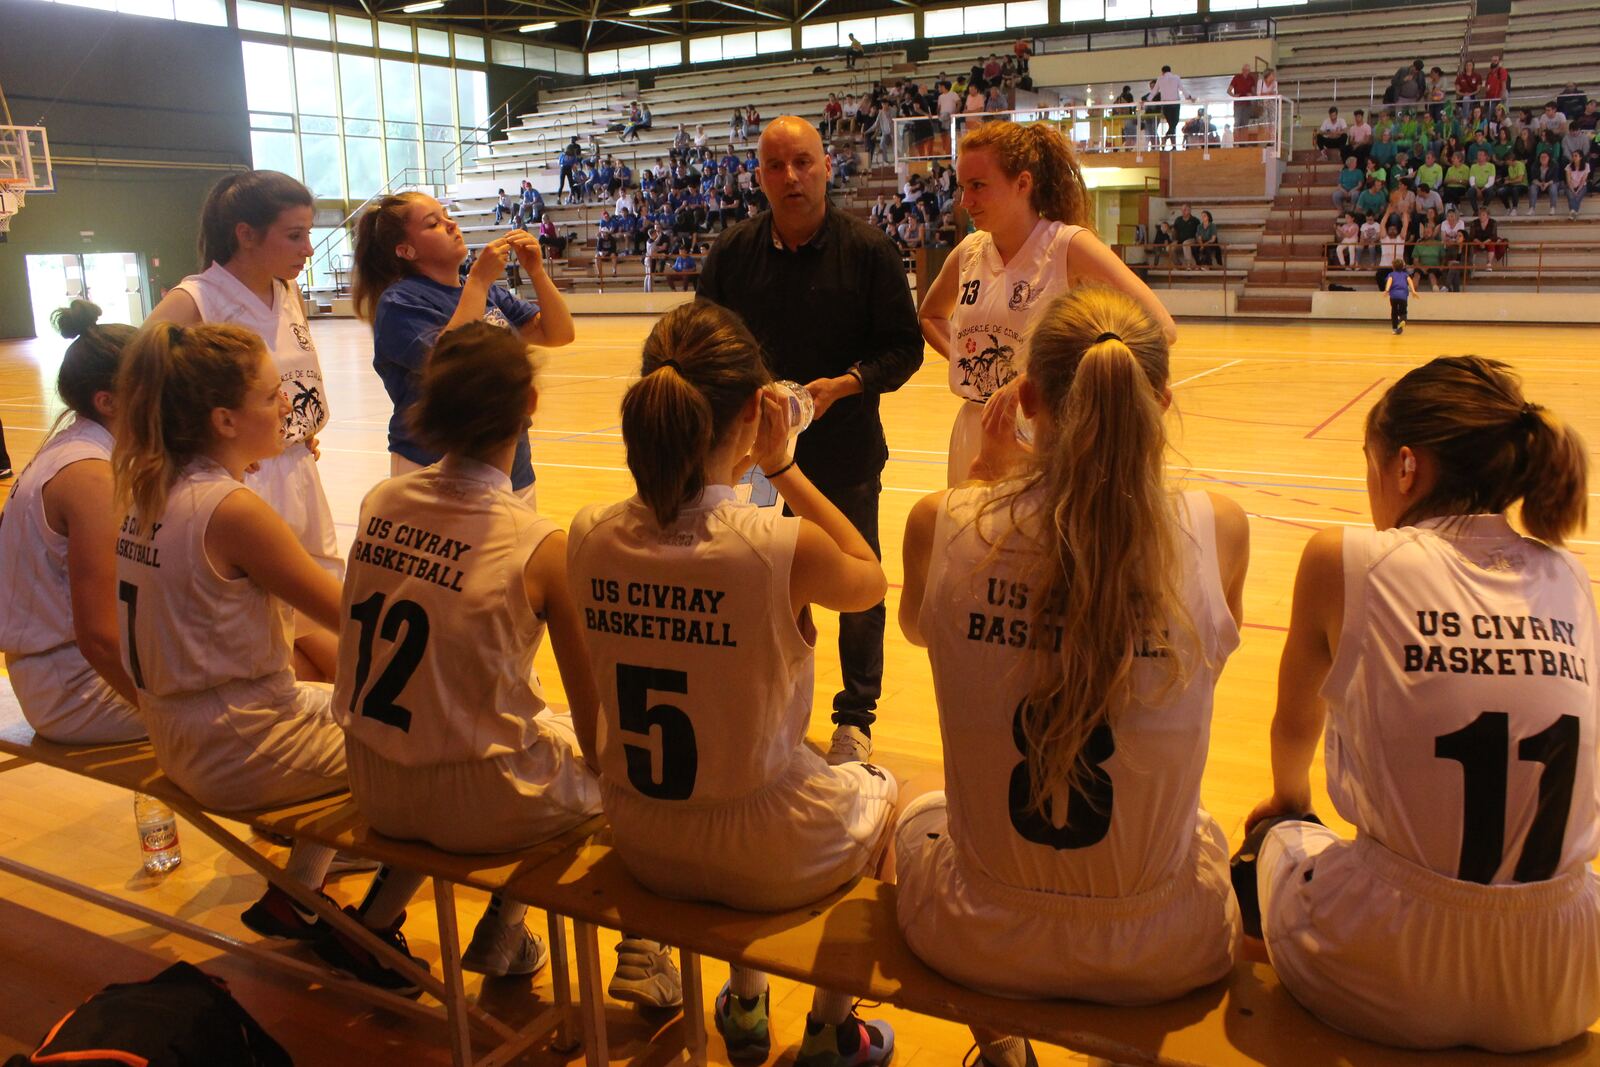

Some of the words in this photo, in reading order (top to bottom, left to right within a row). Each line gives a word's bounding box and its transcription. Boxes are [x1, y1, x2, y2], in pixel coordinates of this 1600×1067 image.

[960, 279, 981, 306] 13
[366, 517, 393, 540] US
[394, 524, 472, 562] CIVRAY
[591, 577, 620, 604] US
[627, 582, 725, 614] CIVRAY
[987, 577, 1028, 610] US
[585, 607, 737, 648] BASKETBALL
[1416, 610, 1462, 638] US
[1472, 614, 1576, 647] CIVRAY
[349, 591, 430, 734] 12
[616, 662, 698, 801] 5
[1007, 692, 1116, 851] 8
[1434, 711, 1580, 886] 11
